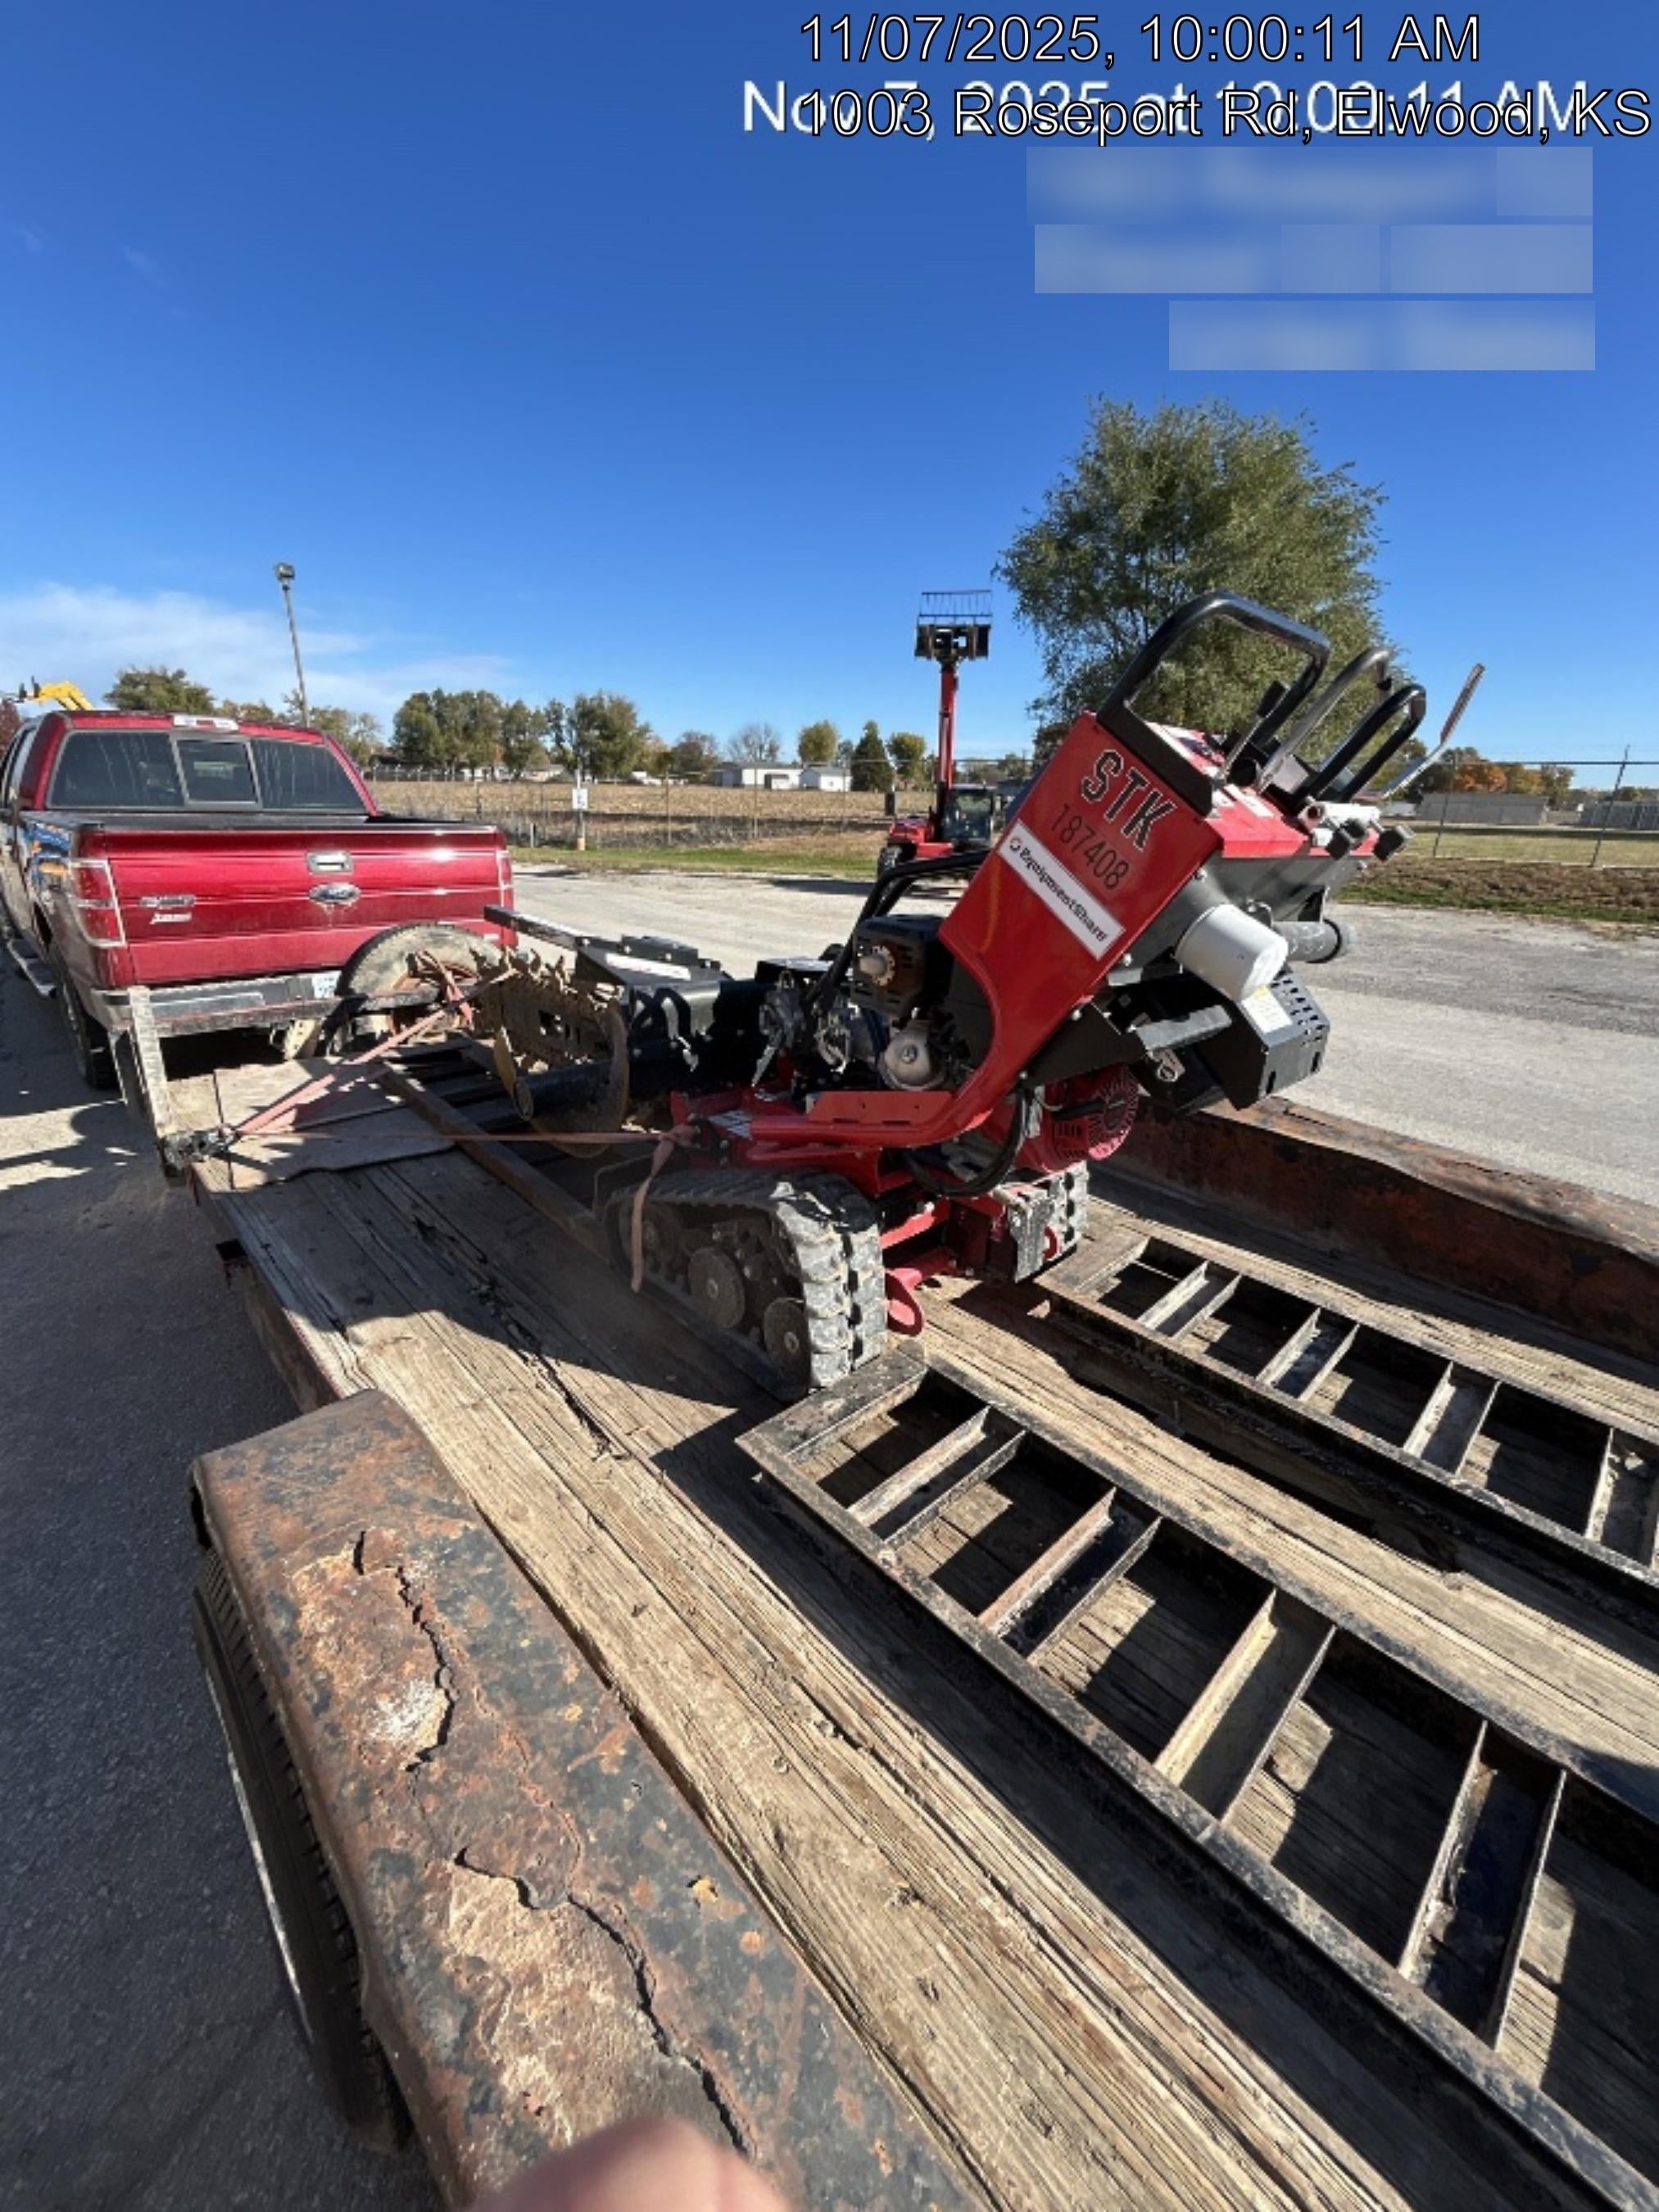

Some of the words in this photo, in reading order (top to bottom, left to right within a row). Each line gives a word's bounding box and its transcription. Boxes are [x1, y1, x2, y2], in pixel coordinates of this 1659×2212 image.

[1050, 803, 1130, 891] 187408
[1081, 749, 1178, 852] STK
[1018, 846, 1108, 943] EquipmentShare
